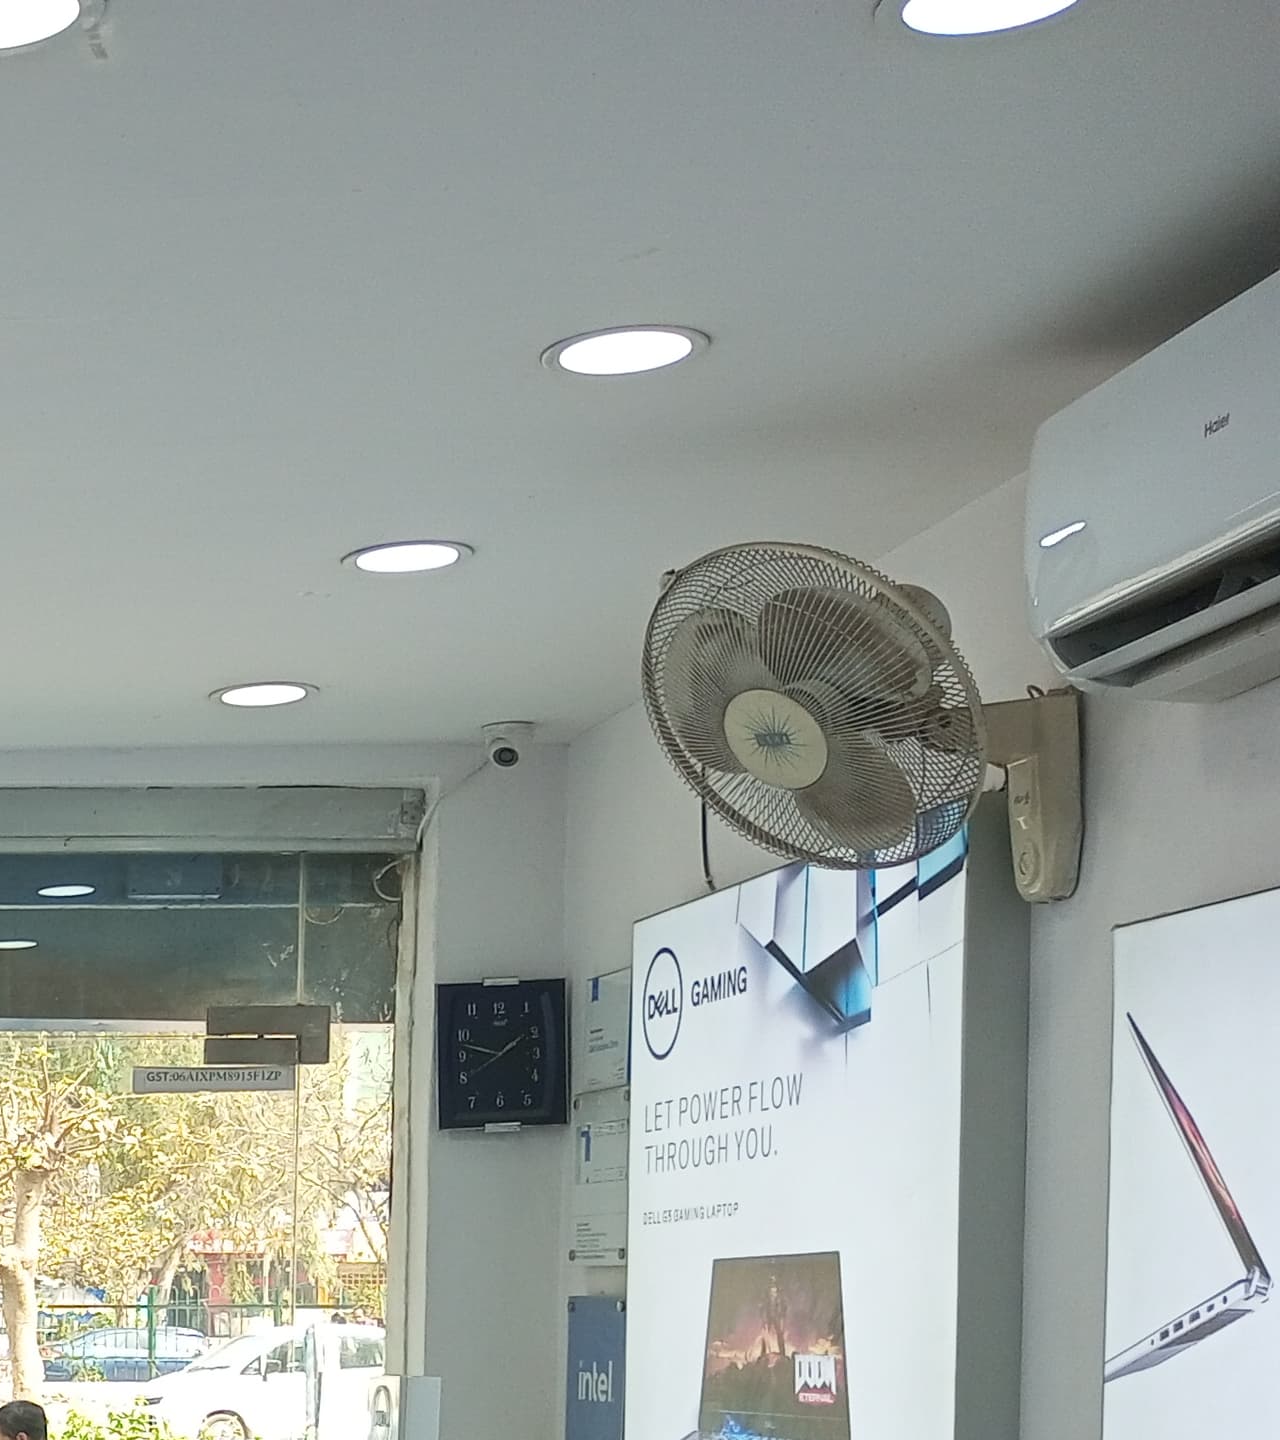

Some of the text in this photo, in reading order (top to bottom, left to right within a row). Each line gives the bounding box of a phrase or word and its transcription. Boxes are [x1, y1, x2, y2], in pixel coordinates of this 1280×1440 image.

[1204, 412, 1230, 438] Haier
[648, 966, 748, 1020] DELL GAMING
[644, 1072, 803, 1134] LET POWER FLOW
[644, 1124, 778, 1175] THROUGH YOU.
[578, 1360, 614, 1402] intel
